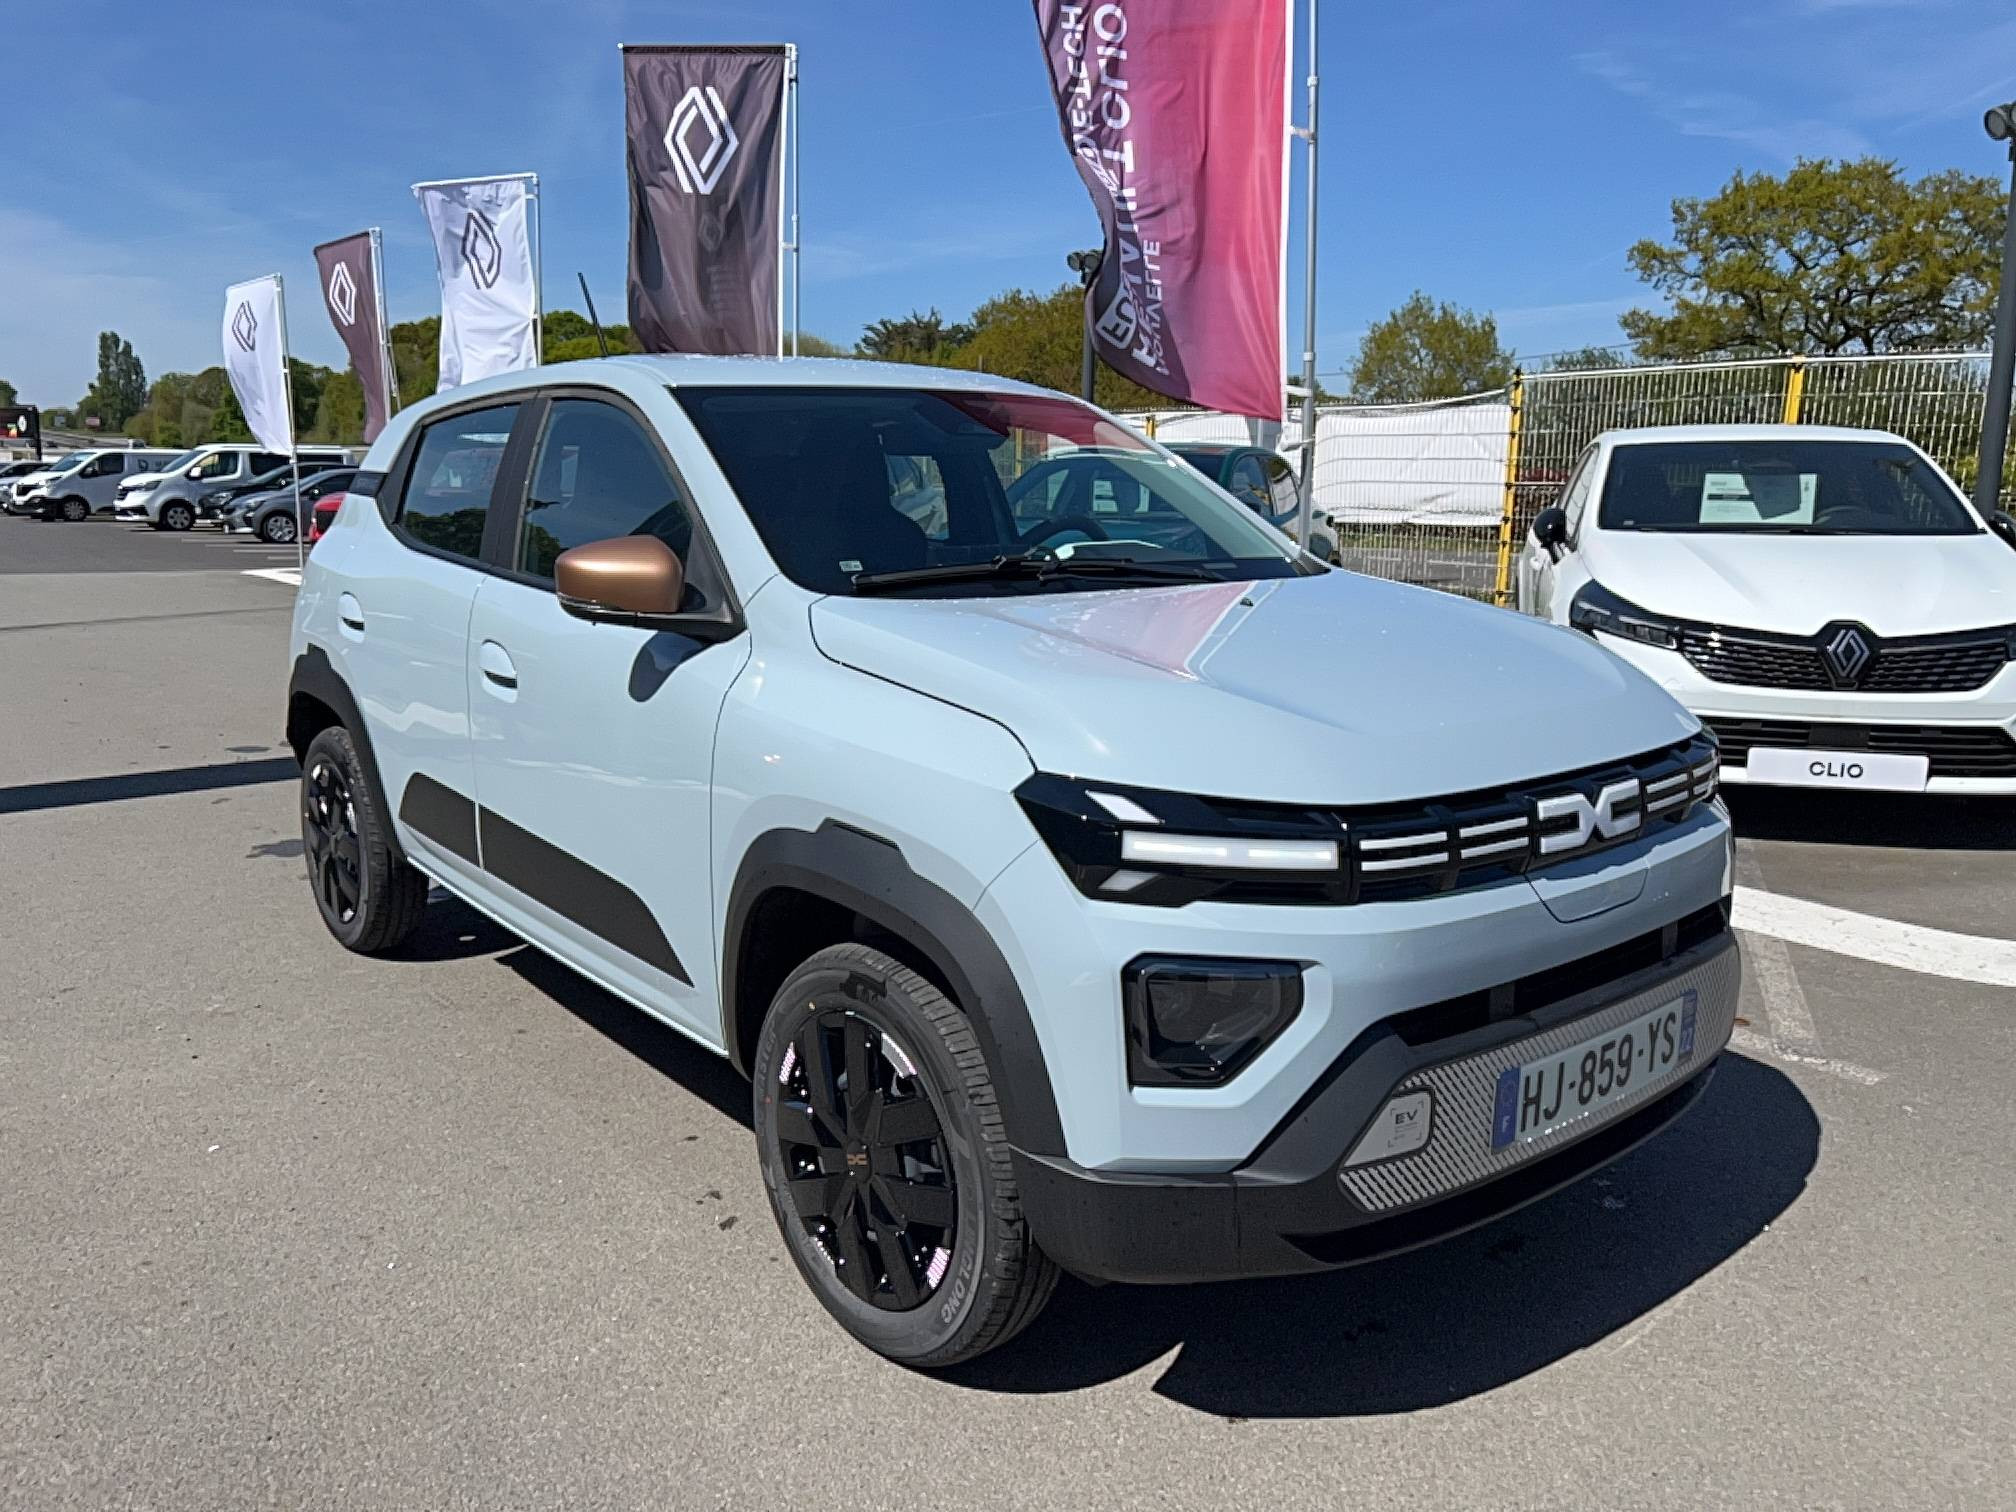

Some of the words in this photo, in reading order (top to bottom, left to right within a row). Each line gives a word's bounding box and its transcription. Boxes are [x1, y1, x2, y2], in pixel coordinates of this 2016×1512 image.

[1809, 761, 1864, 778] CLIO
[1520, 1011, 1676, 1132] HJ-859-YS
[1395, 1108, 1418, 1125] EV
